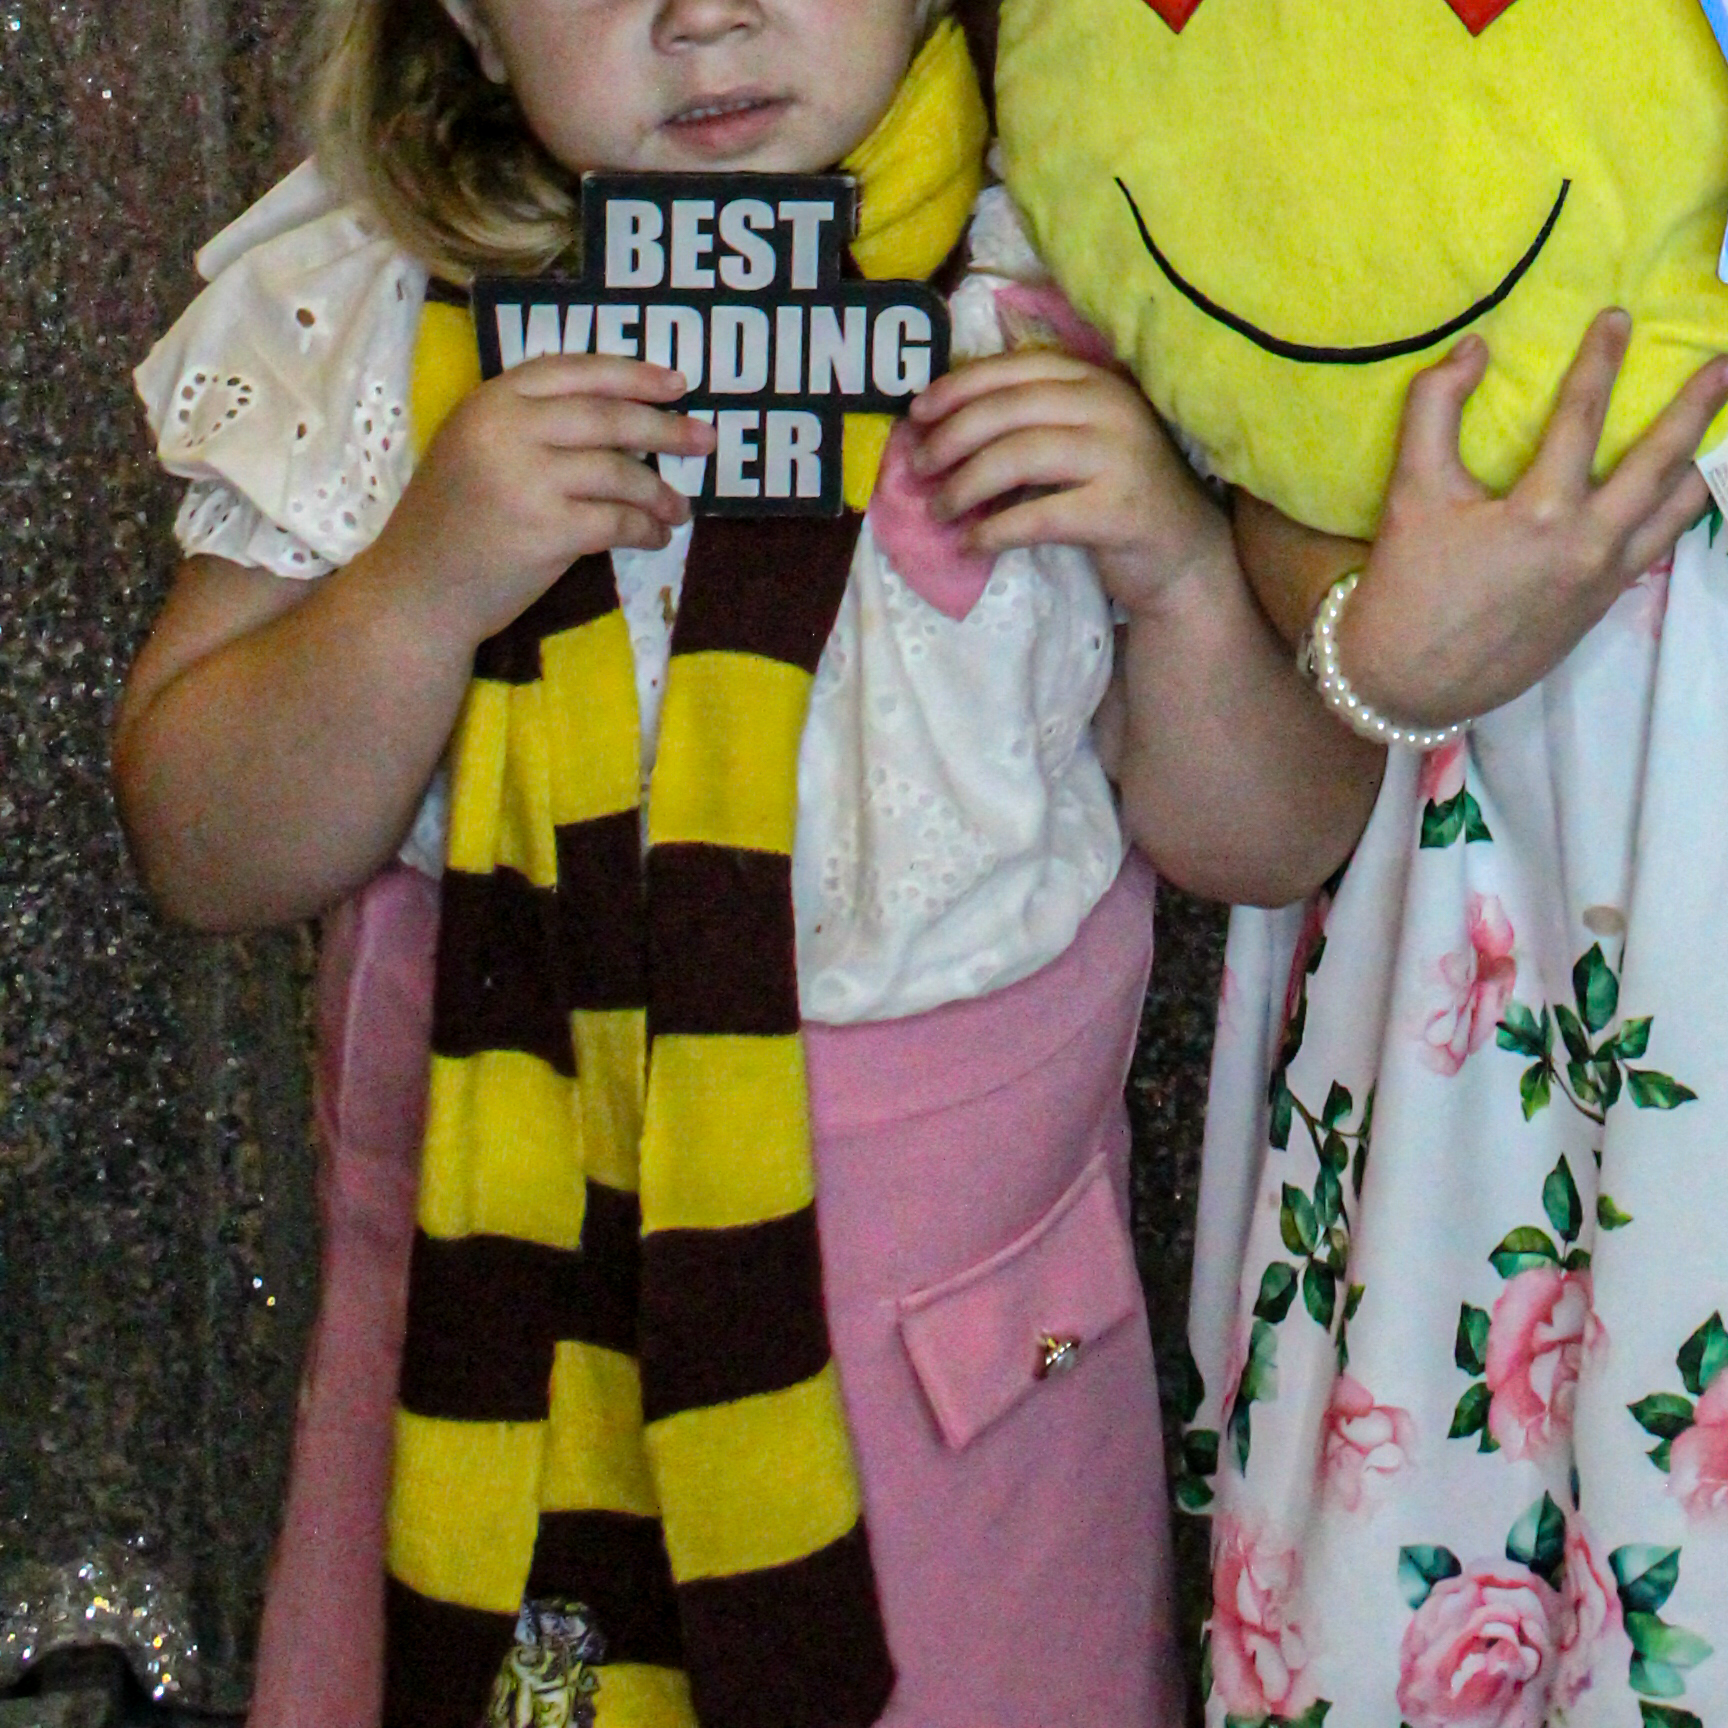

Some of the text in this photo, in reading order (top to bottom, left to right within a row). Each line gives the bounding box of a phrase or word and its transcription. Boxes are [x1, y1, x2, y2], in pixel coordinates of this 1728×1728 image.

[603, 198, 835, 292] BEST
[494, 302, 933, 398] WEDDING
[636, 408, 824, 499] VER
